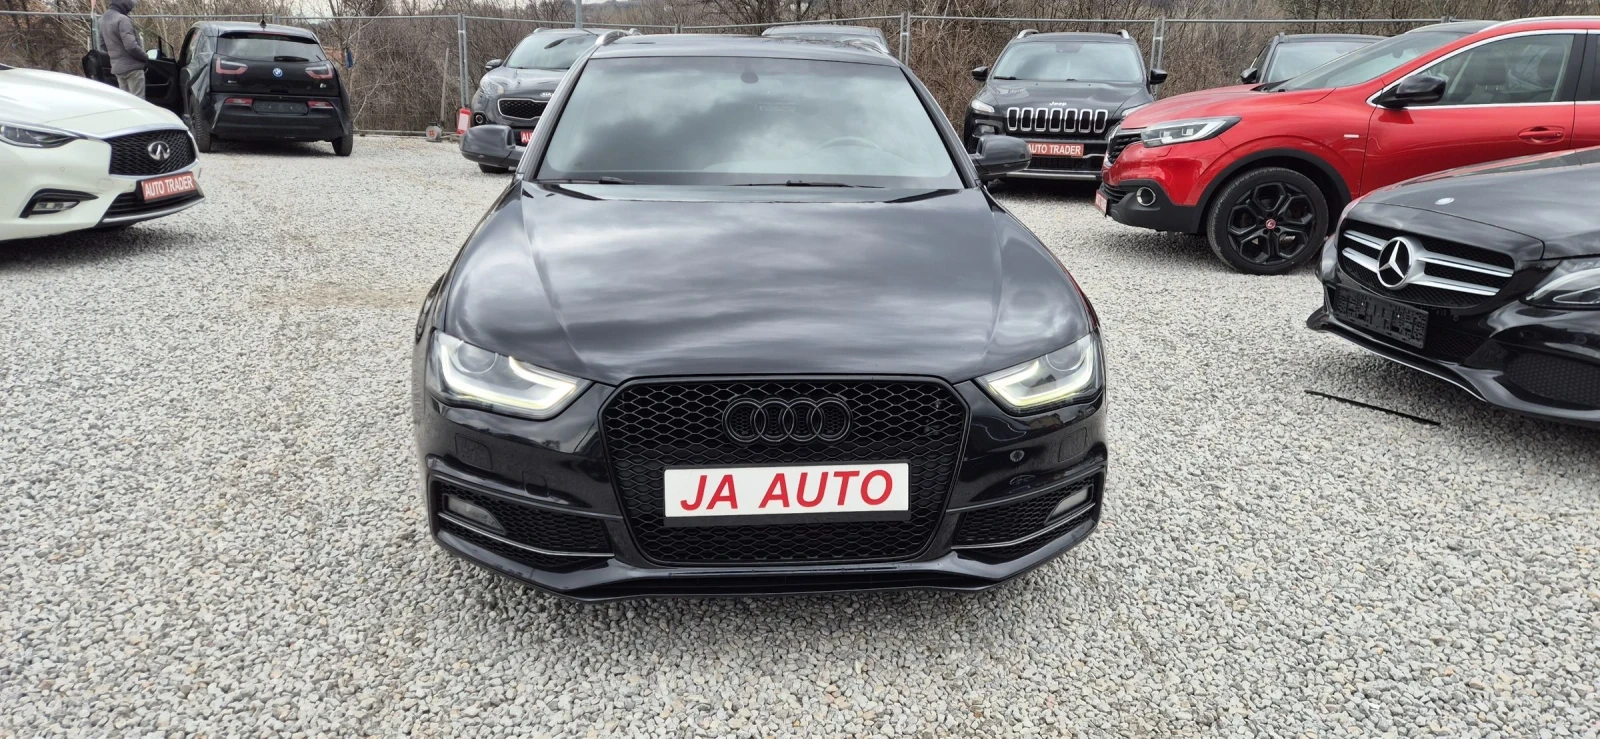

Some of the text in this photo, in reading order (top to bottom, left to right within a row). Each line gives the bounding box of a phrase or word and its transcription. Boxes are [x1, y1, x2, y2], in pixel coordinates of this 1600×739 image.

[1049, 144, 1082, 155] TRADER
[145, 175, 195, 198] AUTO TRADER
[680, 469, 893, 511] JA AUTO
